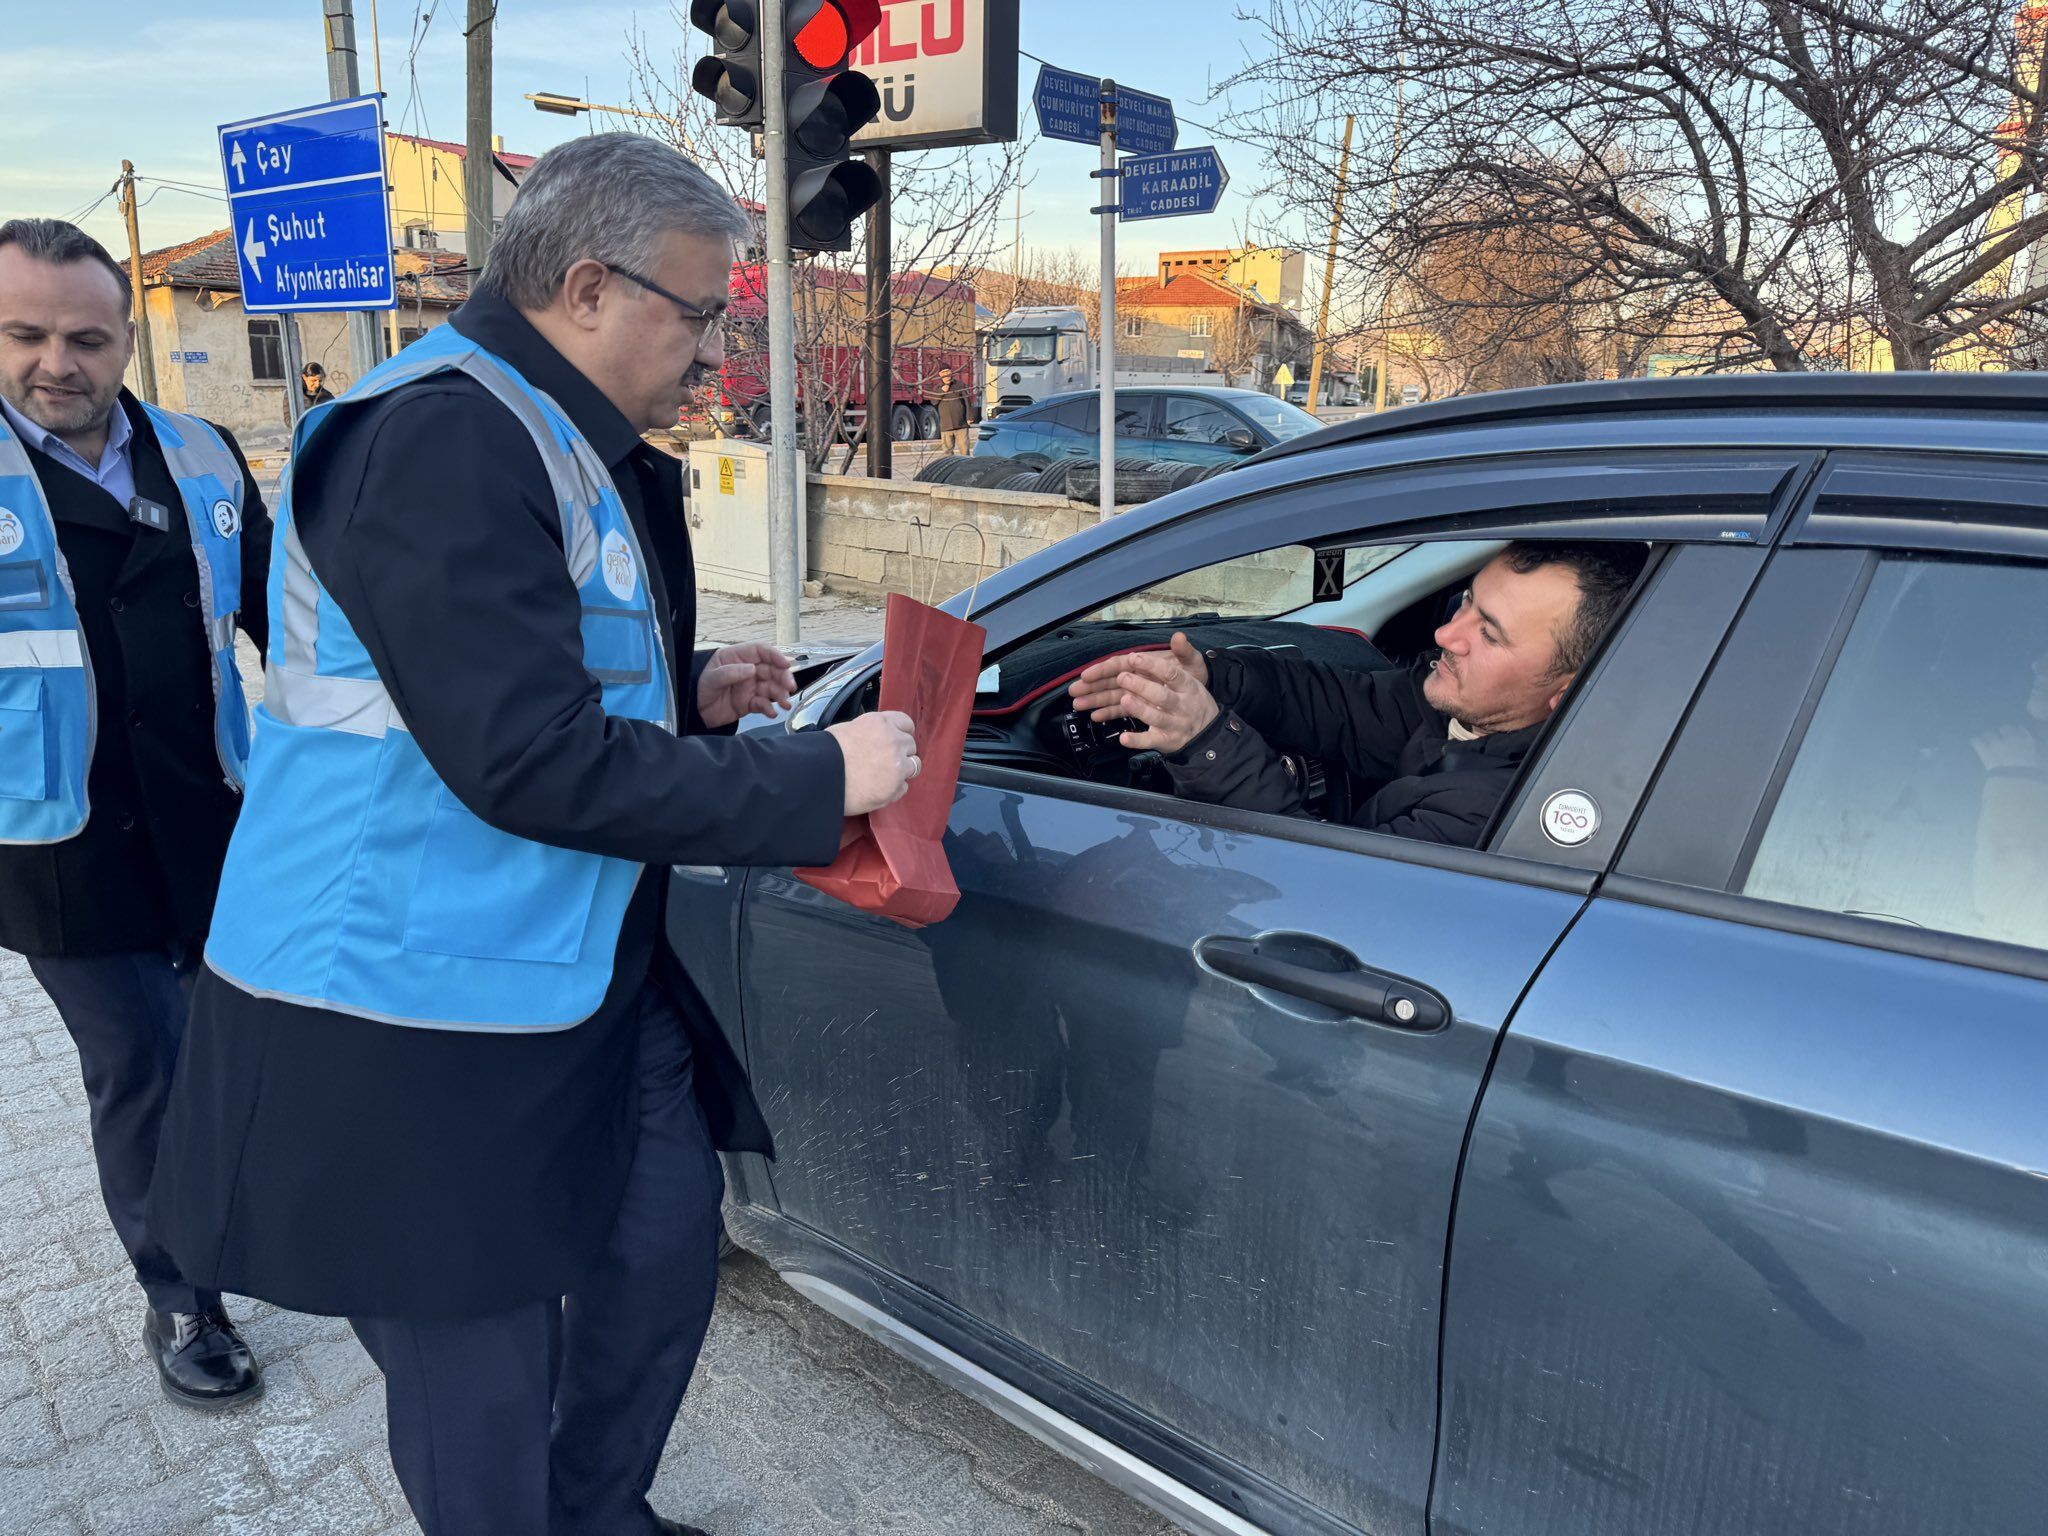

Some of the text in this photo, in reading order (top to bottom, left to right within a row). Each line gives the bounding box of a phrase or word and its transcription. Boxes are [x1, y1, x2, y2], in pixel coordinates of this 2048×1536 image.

[1044, 75, 1072, 94] DEVELİ
[1040, 95, 1095, 119] CUMHURİYET
[1119, 96, 1145, 114] DEVELİ
[1049, 117, 1081, 134] CADDESİ
[256, 141, 292, 176] Çay
[1125, 158, 1167, 178] DEVELİ
[1142, 172, 1212, 195] KARAADİL
[1150, 192, 1200, 211] CADDESİ
[267, 211, 326, 247] Şuhut
[276, 260, 385, 300] Afyonkarahisar
